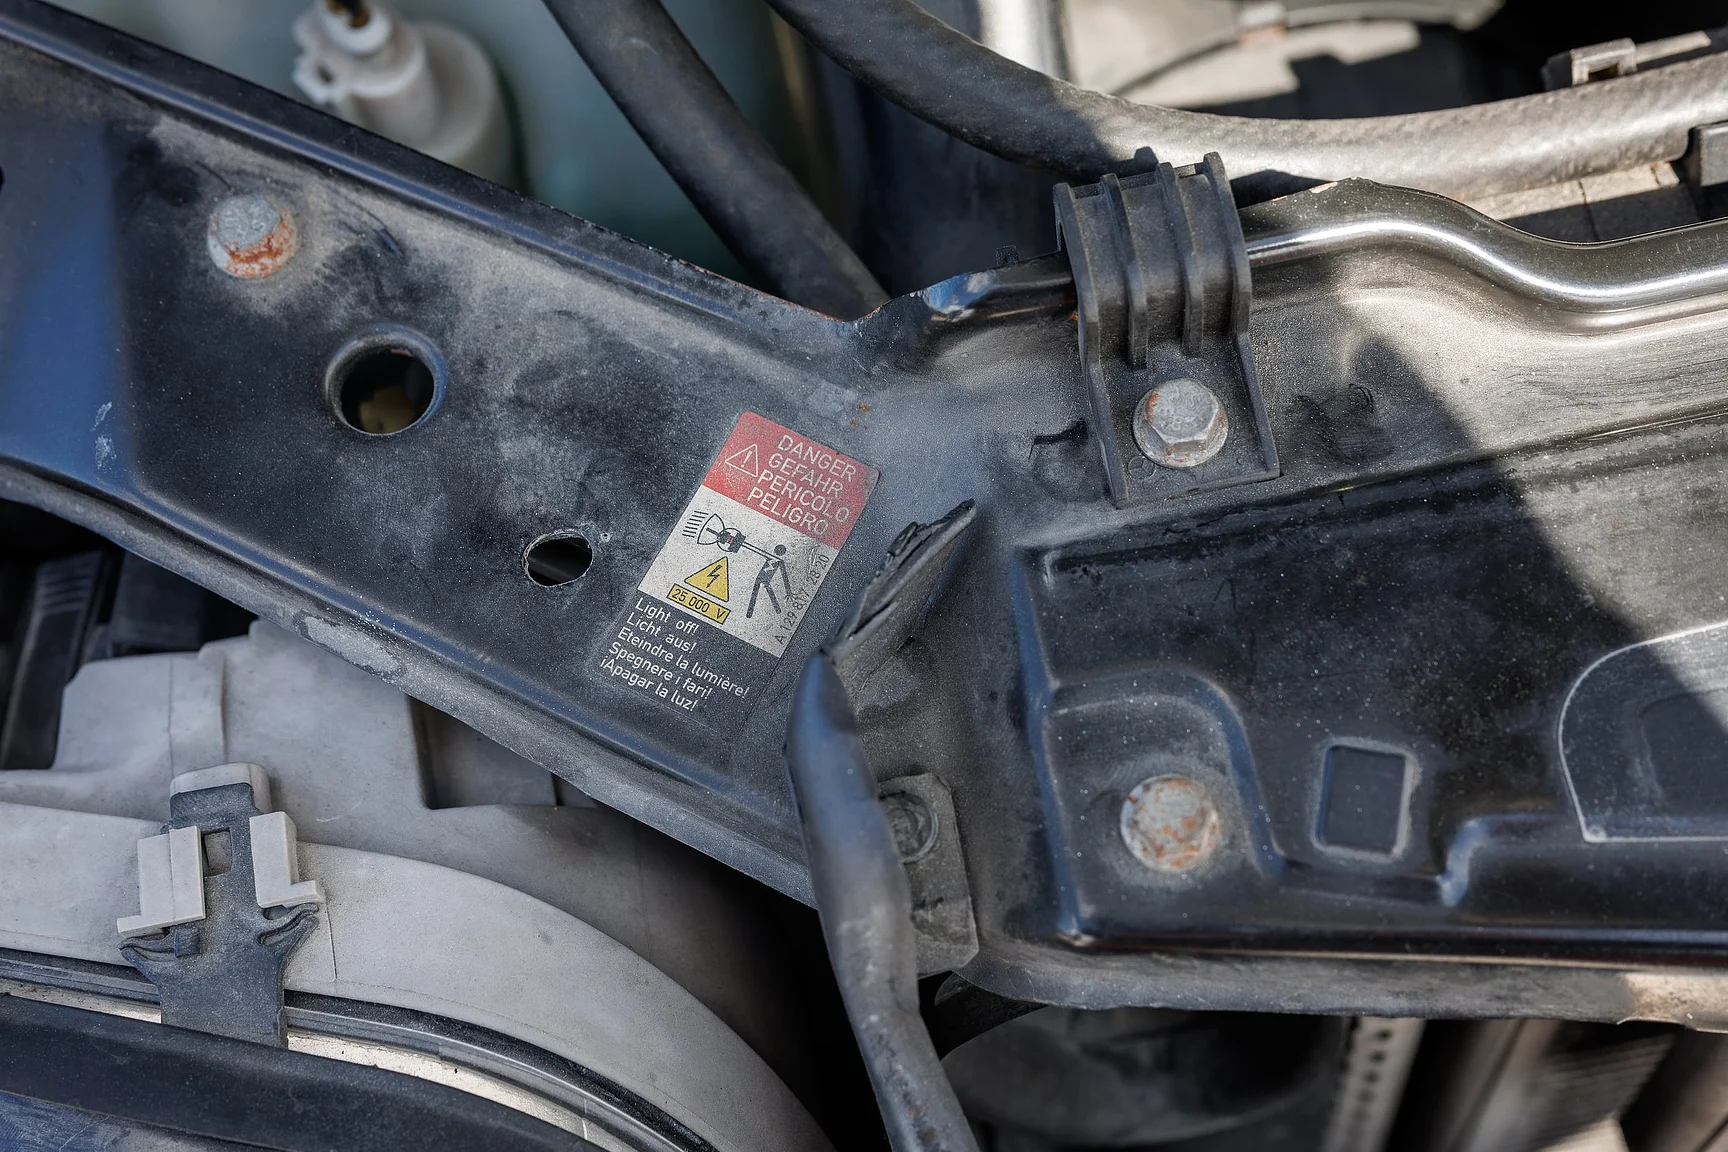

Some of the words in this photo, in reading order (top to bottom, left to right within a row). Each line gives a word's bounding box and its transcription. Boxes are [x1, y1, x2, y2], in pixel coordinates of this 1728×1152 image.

[768, 452, 844, 499] GEFAHR
[777, 434, 857, 482] DANGER
[747, 486, 829, 535] PELIGRO
[757, 469, 850, 523] PERICOLO
[635, 597, 671, 623] Light
[675, 620, 700, 636] off!
[671, 588, 689, 602] 25
[688, 596, 711, 613] 000
[716, 608, 726, 620] V
[780, 611, 798, 631] 129
[626, 611, 662, 637] Licht
[665, 634, 698, 654] aus!
[774, 635, 787, 645] A
[608, 641, 673, 681] Spegnere
[674, 673, 683, 685] i
[682, 677, 713, 700] fari!
[617, 626, 674, 662] Eteindre
[675, 654, 689, 670] la
[691, 661, 750, 699] lumière!
[655, 682, 669, 698] la
[670, 689, 699, 712] luz!
